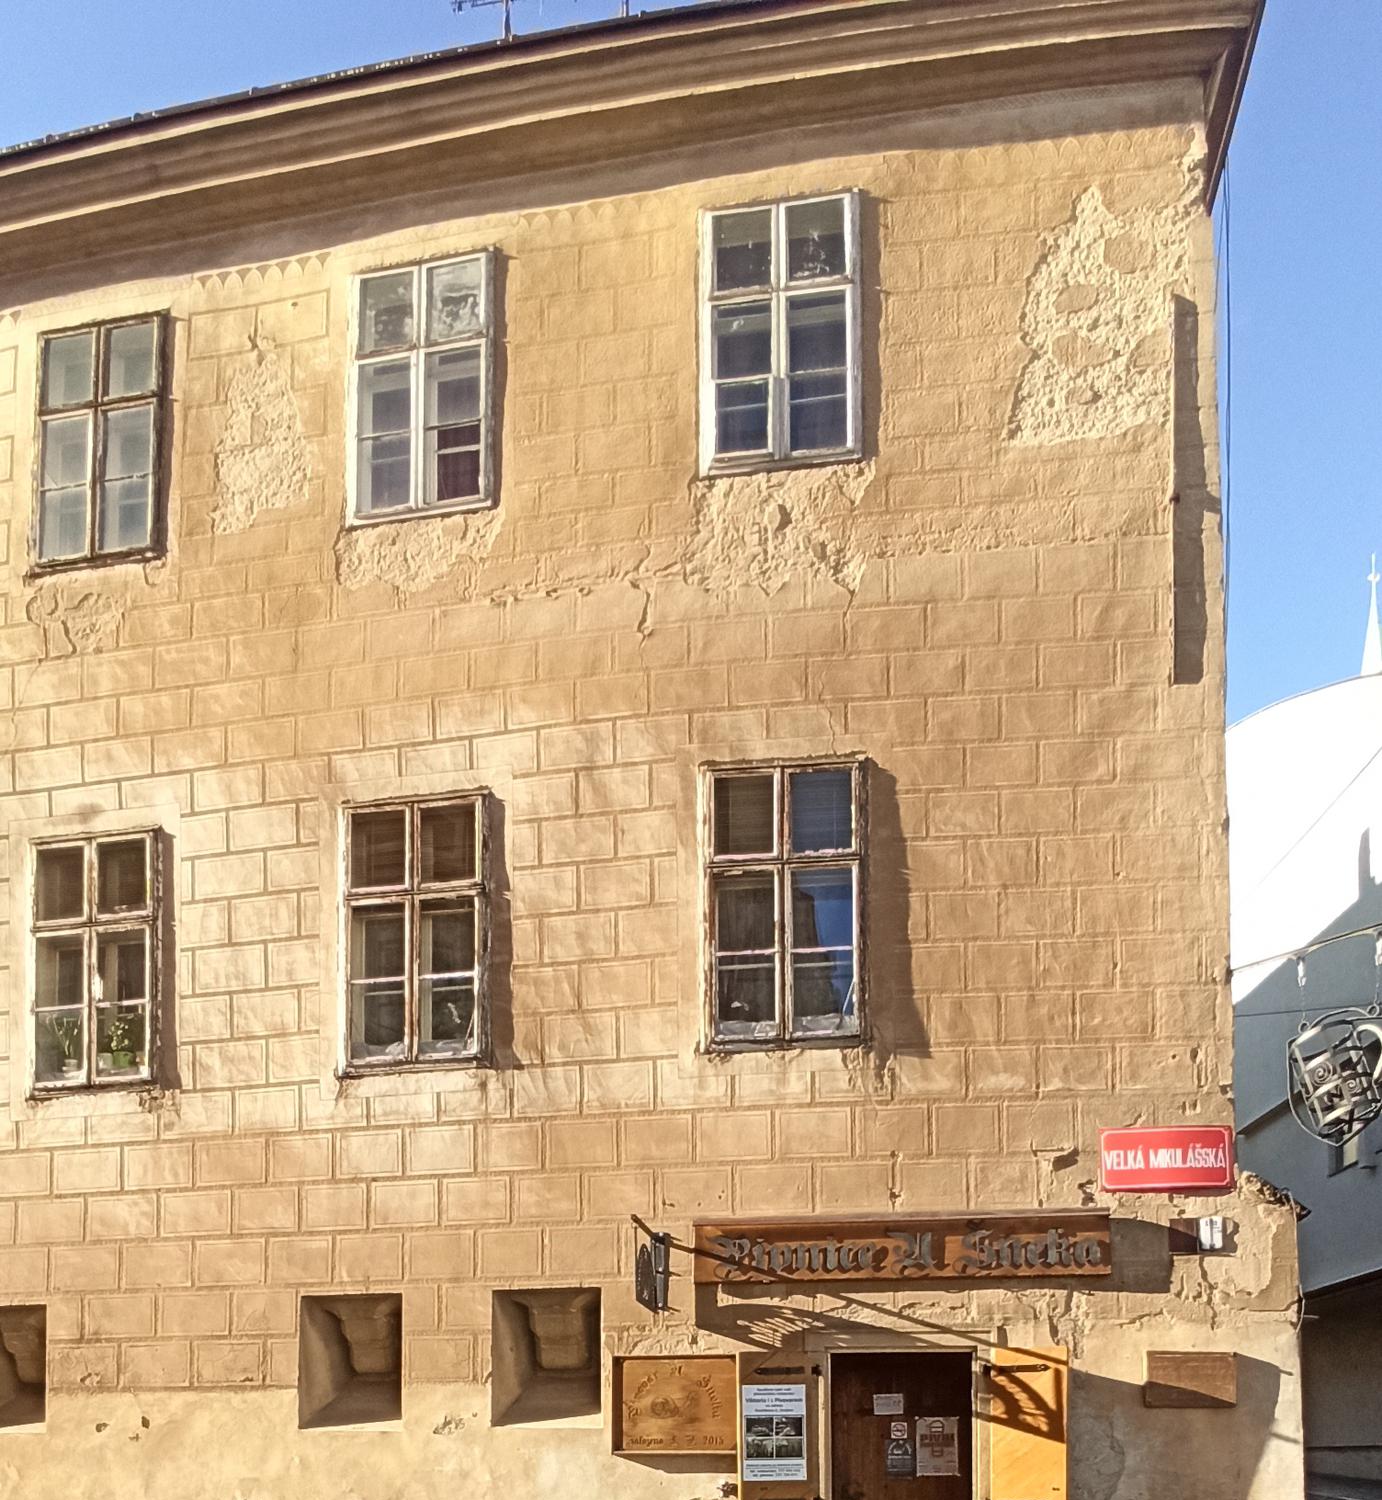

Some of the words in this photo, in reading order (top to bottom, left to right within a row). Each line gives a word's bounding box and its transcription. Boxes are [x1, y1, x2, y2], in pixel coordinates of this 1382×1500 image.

[1104, 1145, 1145, 1170] VELKÁ
[1149, 1143, 1225, 1168] MIKULÁŠSKÁ
[706, 1235, 876, 1281] Pivnice
[887, 1232, 936, 1275] U
